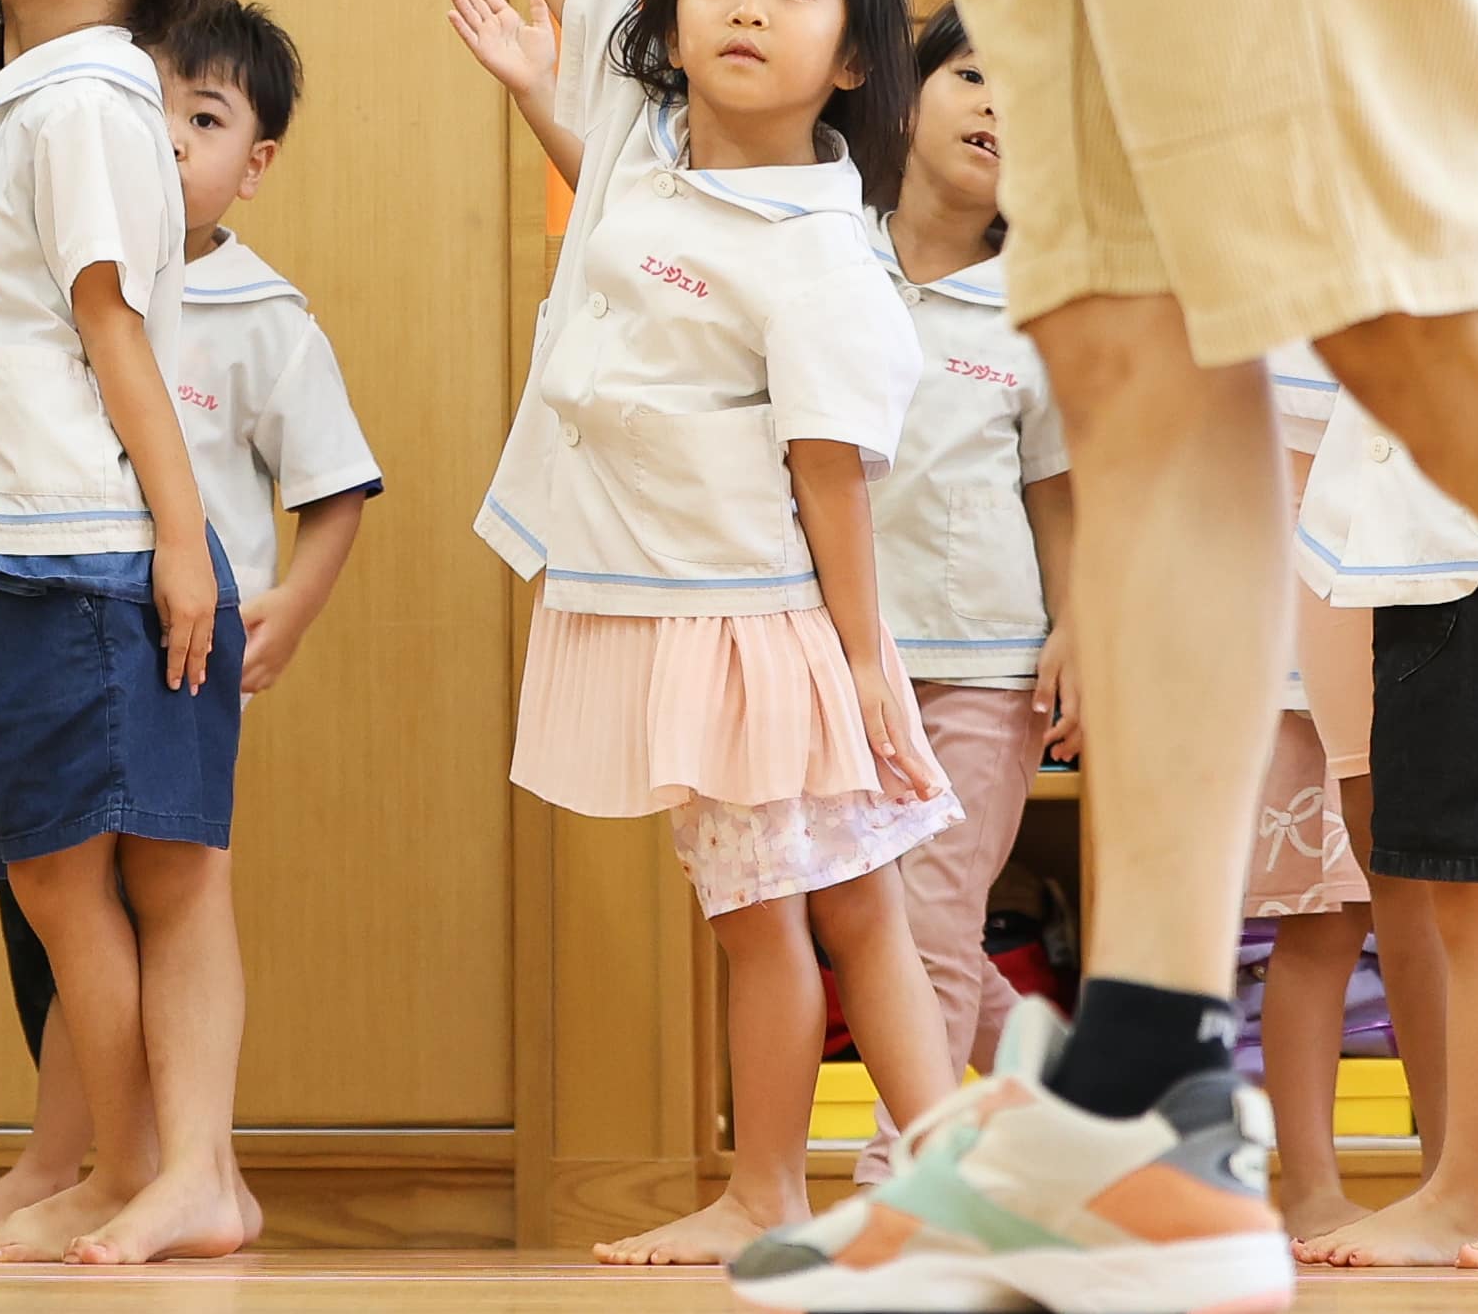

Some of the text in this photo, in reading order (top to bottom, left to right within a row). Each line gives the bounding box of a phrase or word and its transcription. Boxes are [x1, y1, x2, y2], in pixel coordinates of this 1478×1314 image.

[640, 255, 709, 299] エンジェル
[945, 357, 1019, 389] エンジェル
